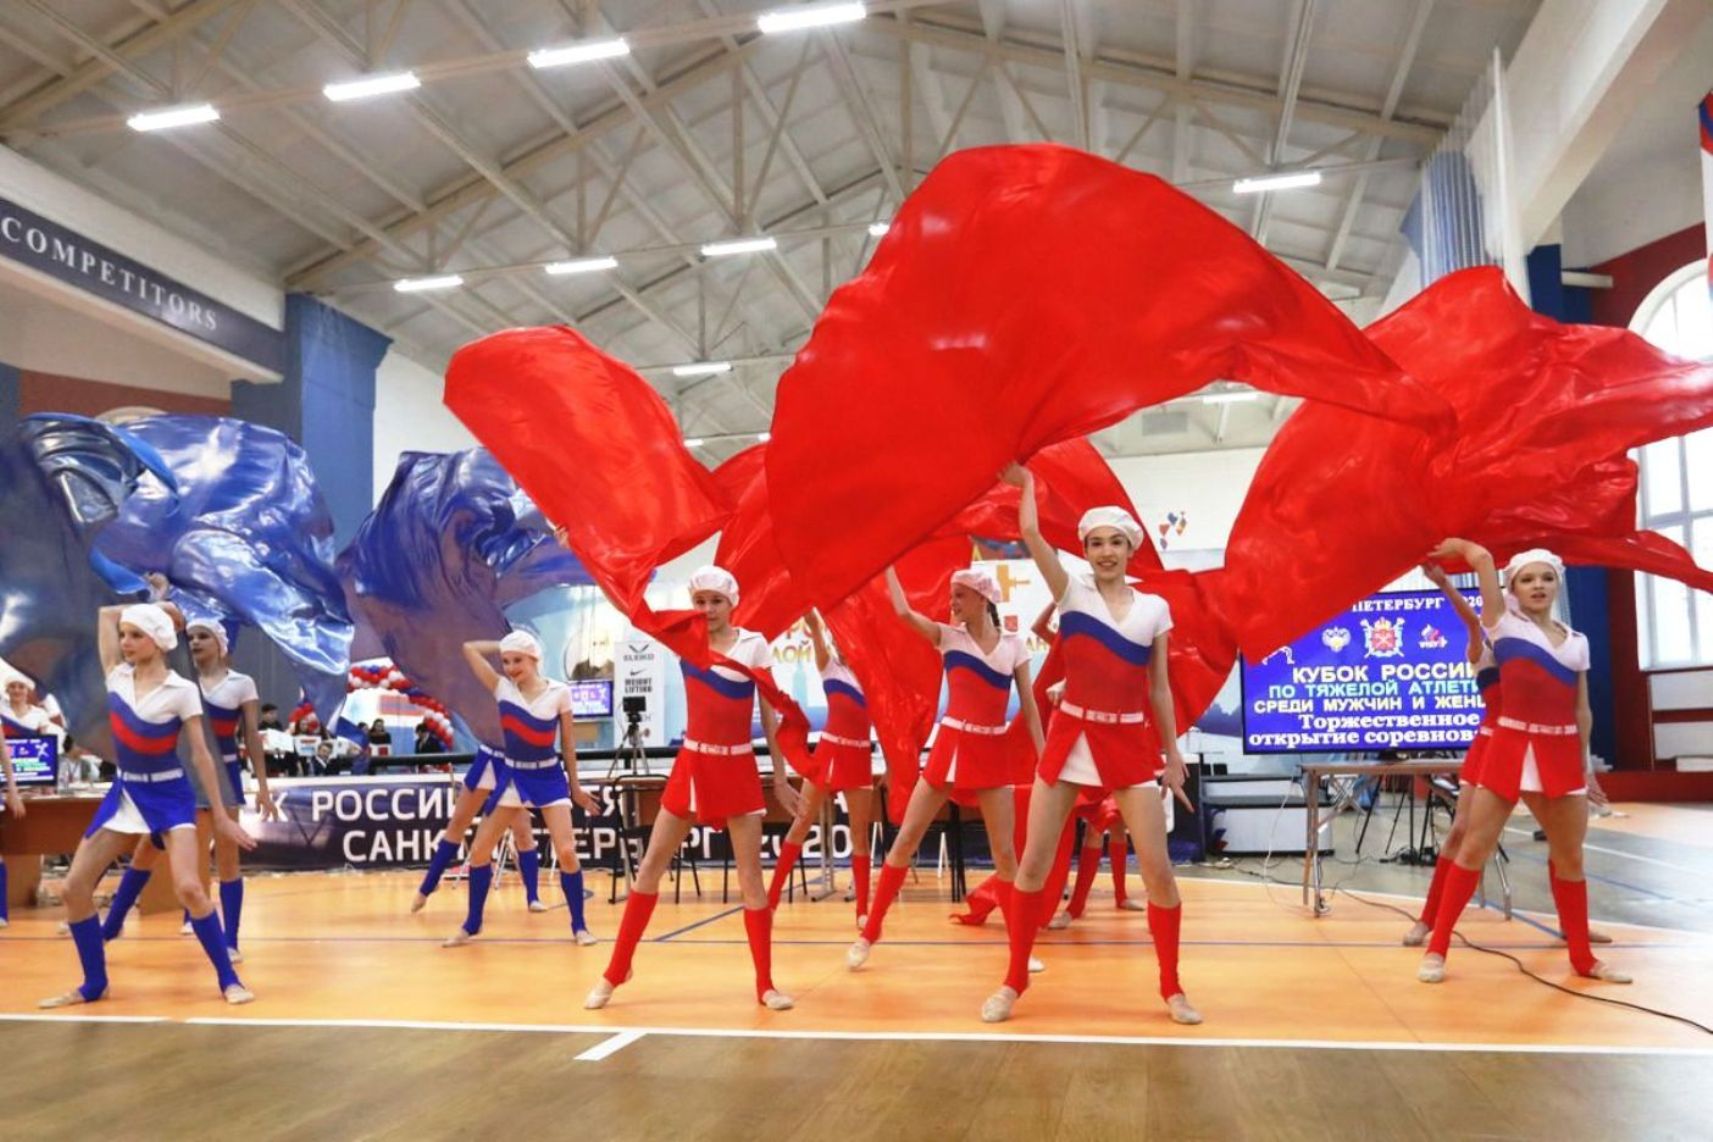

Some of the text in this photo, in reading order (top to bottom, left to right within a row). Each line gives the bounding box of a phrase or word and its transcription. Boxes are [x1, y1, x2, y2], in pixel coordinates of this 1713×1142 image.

[1, 216, 217, 331] COMPETITORS
[1293, 665, 1369, 683] КУБОК
[1269, 684, 1295, 698] ПО
[1305, 679, 1398, 697] ТЯЖЕЛОЙ
[1254, 698, 1314, 713] СРЕДИ
[1323, 696, 1403, 711] МУЖЧИН
[1412, 695, 1425, 709] И
[1298, 713, 1480, 732] Торжественное
[1249, 729, 1478, 749] открытие соревнов
